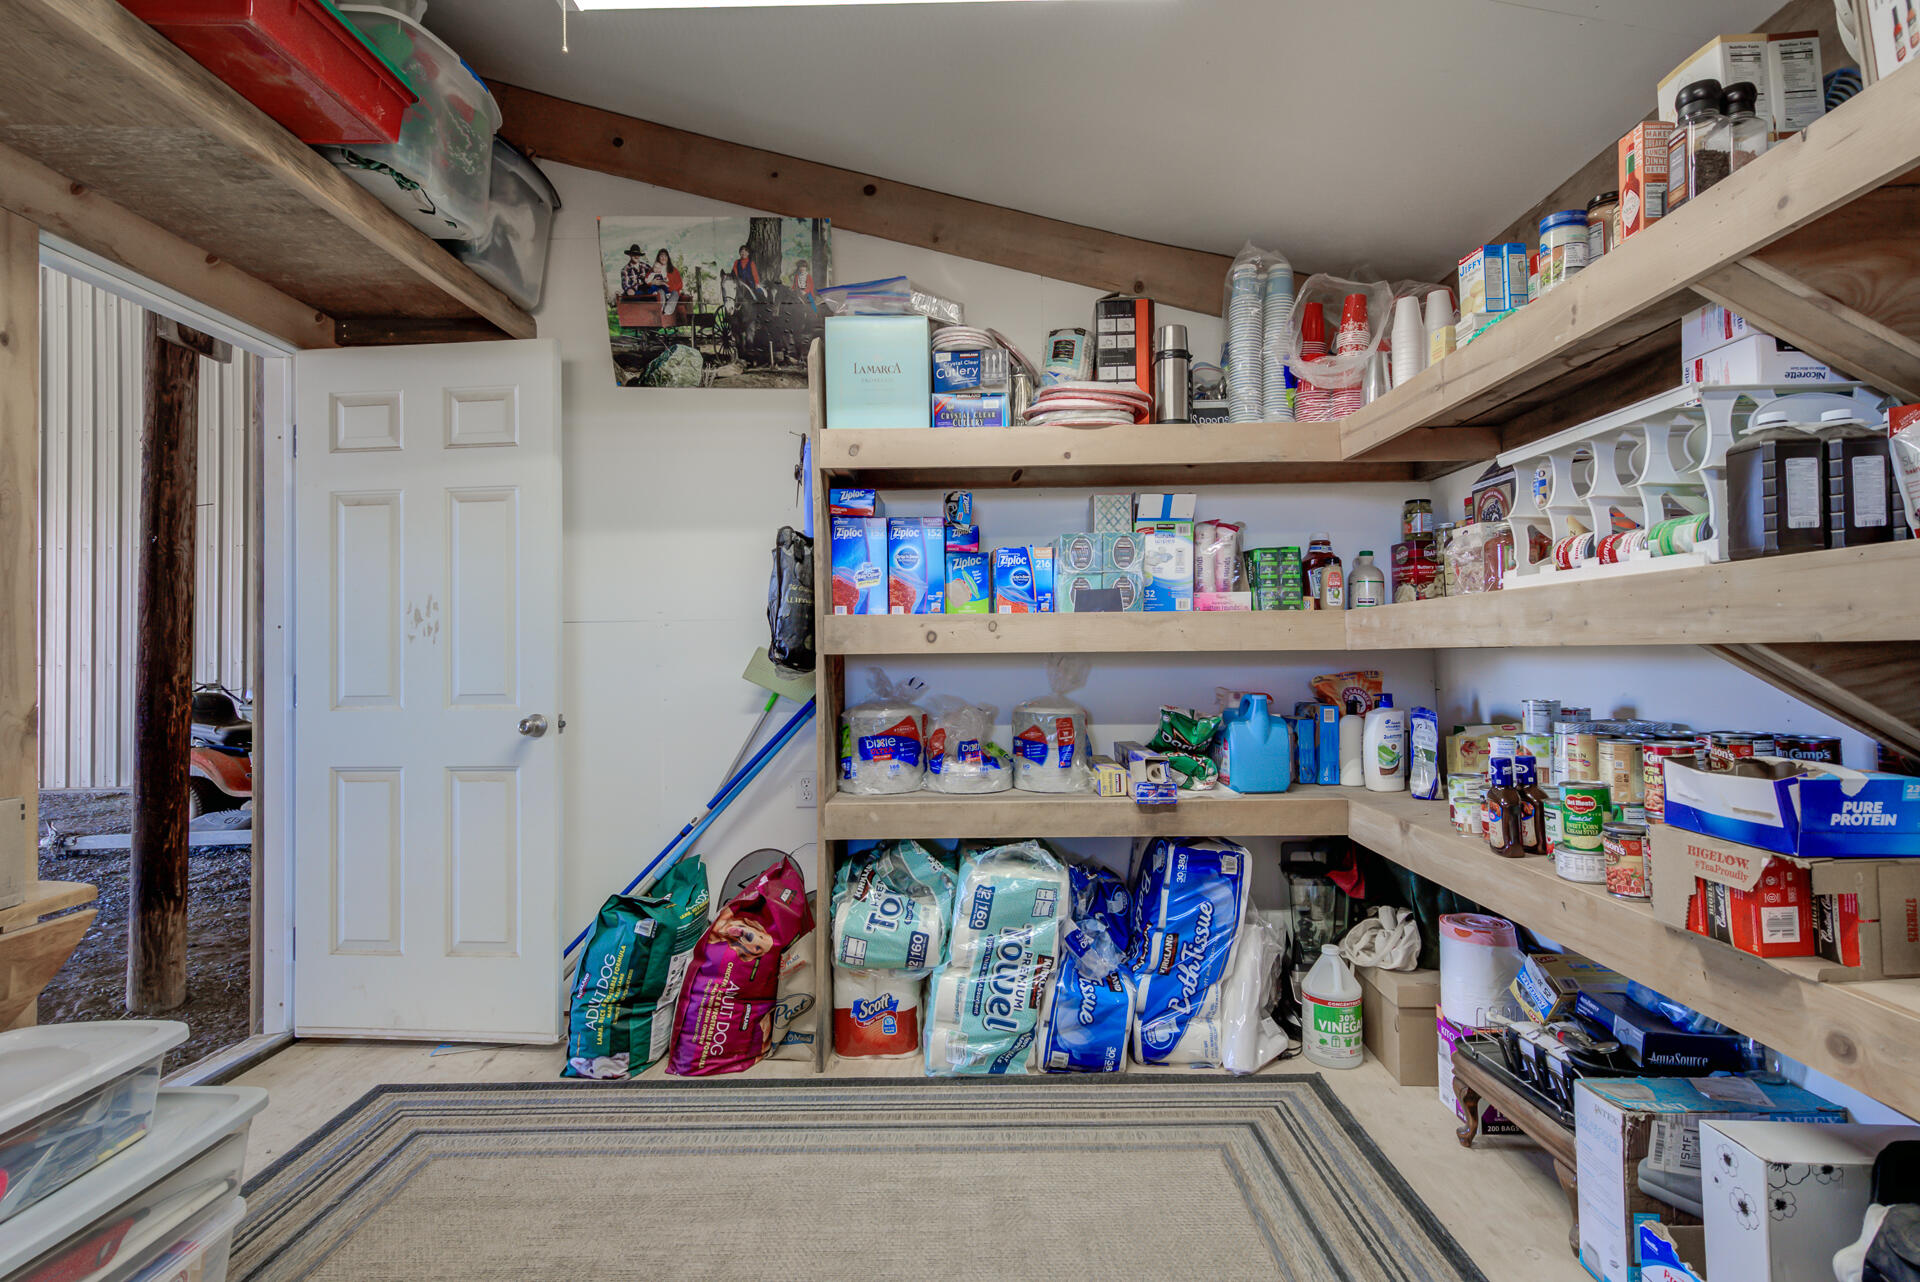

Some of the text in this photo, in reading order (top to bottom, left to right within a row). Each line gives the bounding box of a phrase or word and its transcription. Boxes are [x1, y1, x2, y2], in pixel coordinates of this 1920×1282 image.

[1459, 257, 1482, 277] JIFFY
[936, 366, 978, 380] Cutlery
[1785, 371, 1826, 380] Nicorette
[840, 490, 864, 501] Ziploc
[836, 527, 863, 540] Ziploc
[893, 527, 920, 540] Ziploc
[927, 528, 942, 537] 152
[952, 556, 982, 570] Ziploc
[1000, 555, 1027, 568] Ziploc
[1035, 560, 1051, 568] 216
[1144, 590, 1156, 598] 32
[1789, 747, 1831, 761] Camp's
[1842, 801, 1883, 813] PURE
[1830, 813, 1897, 826] PROTEIN
[1687, 845, 1749, 870] BIGELOW
[975, 903, 990, 929] 160
[1180, 901, 1214, 960] Tissue
[911, 934, 924, 957] 160
[614, 945, 627, 975] FORMULA
[1159, 933, 1174, 974] KIRKLAND
[984, 927, 1028, 1034] Towel
[1014, 951, 1033, 1012] PREMIUM
[585, 953, 616, 1031] ADULT DOG
[775, 999, 806, 1025] Post
[859, 993, 890, 1018] Scott
[710, 980, 740, 1056] ADULT DOG
[1339, 1014, 1355, 1022] 30%
[1318, 1019, 1361, 1034] VINEGA
[1650, 1050, 1709, 1066] AquaSource
[1681, 1136, 1692, 1161] SMF
